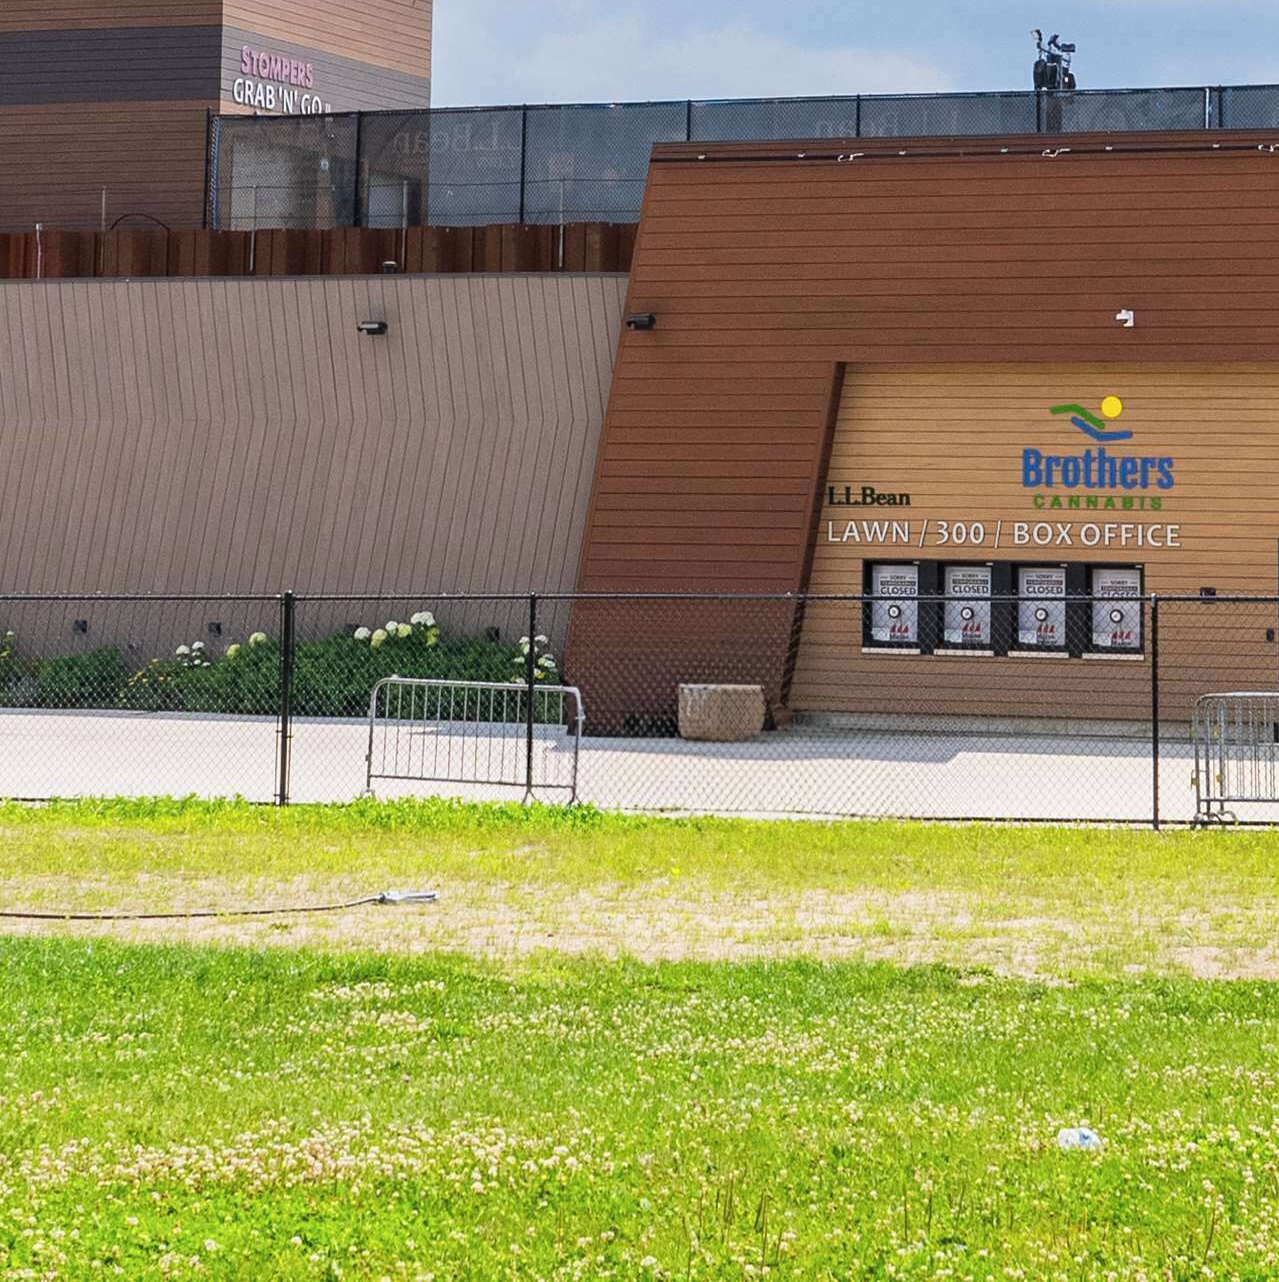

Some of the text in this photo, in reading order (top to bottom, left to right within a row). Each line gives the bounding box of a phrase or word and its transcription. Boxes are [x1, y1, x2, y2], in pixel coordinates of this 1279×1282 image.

[240, 45, 313, 88] STOMPERS
[233, 78, 275, 110] GRAB
[278, 85, 298, 113] 'N'
[301, 94, 322, 114] GO
[1022, 447, 1175, 490] Brothers
[827, 486, 911, 507] L.L.Bean
[1033, 493, 1163, 511] CANNABIS
[827, 519, 1182, 549] LAWN / 300 / BOX OFFICE
[880, 586, 917, 595] CLOSED
[952, 585, 989, 594] CLOSED
[1026, 585, 1063, 594] CLOSED
